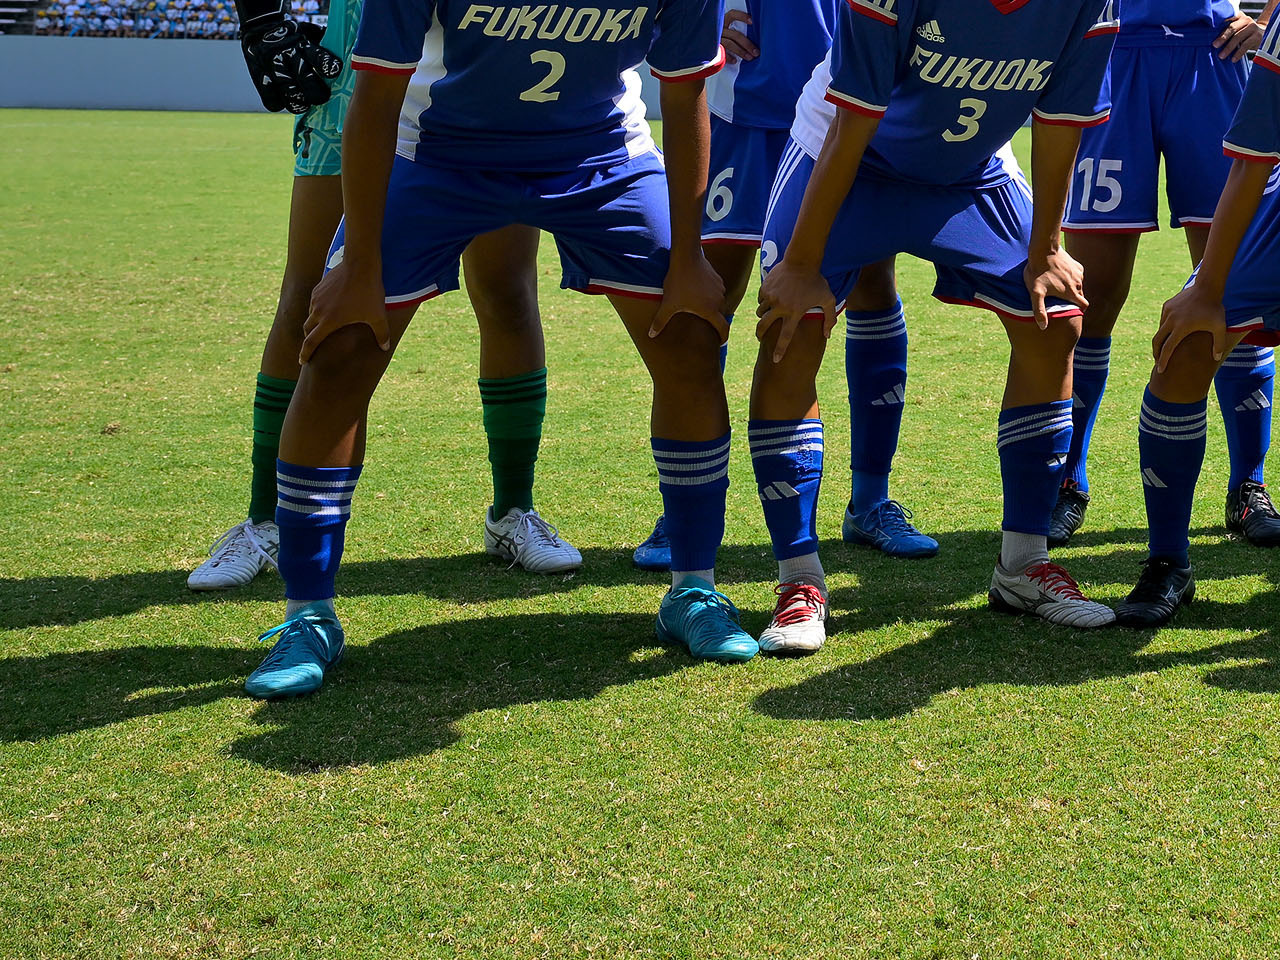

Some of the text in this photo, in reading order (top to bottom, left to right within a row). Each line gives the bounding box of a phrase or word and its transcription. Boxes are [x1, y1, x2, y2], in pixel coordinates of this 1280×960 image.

[457, 4, 649, 43] FUKUOKA
[916, 26, 946, 44] adidas
[519, 49, 566, 103] 2
[909, 44, 1054, 91] FUKUOK
[941, 97, 988, 143] 3
[706, 167, 734, 222] 6
[1078, 157, 1123, 213] 15
